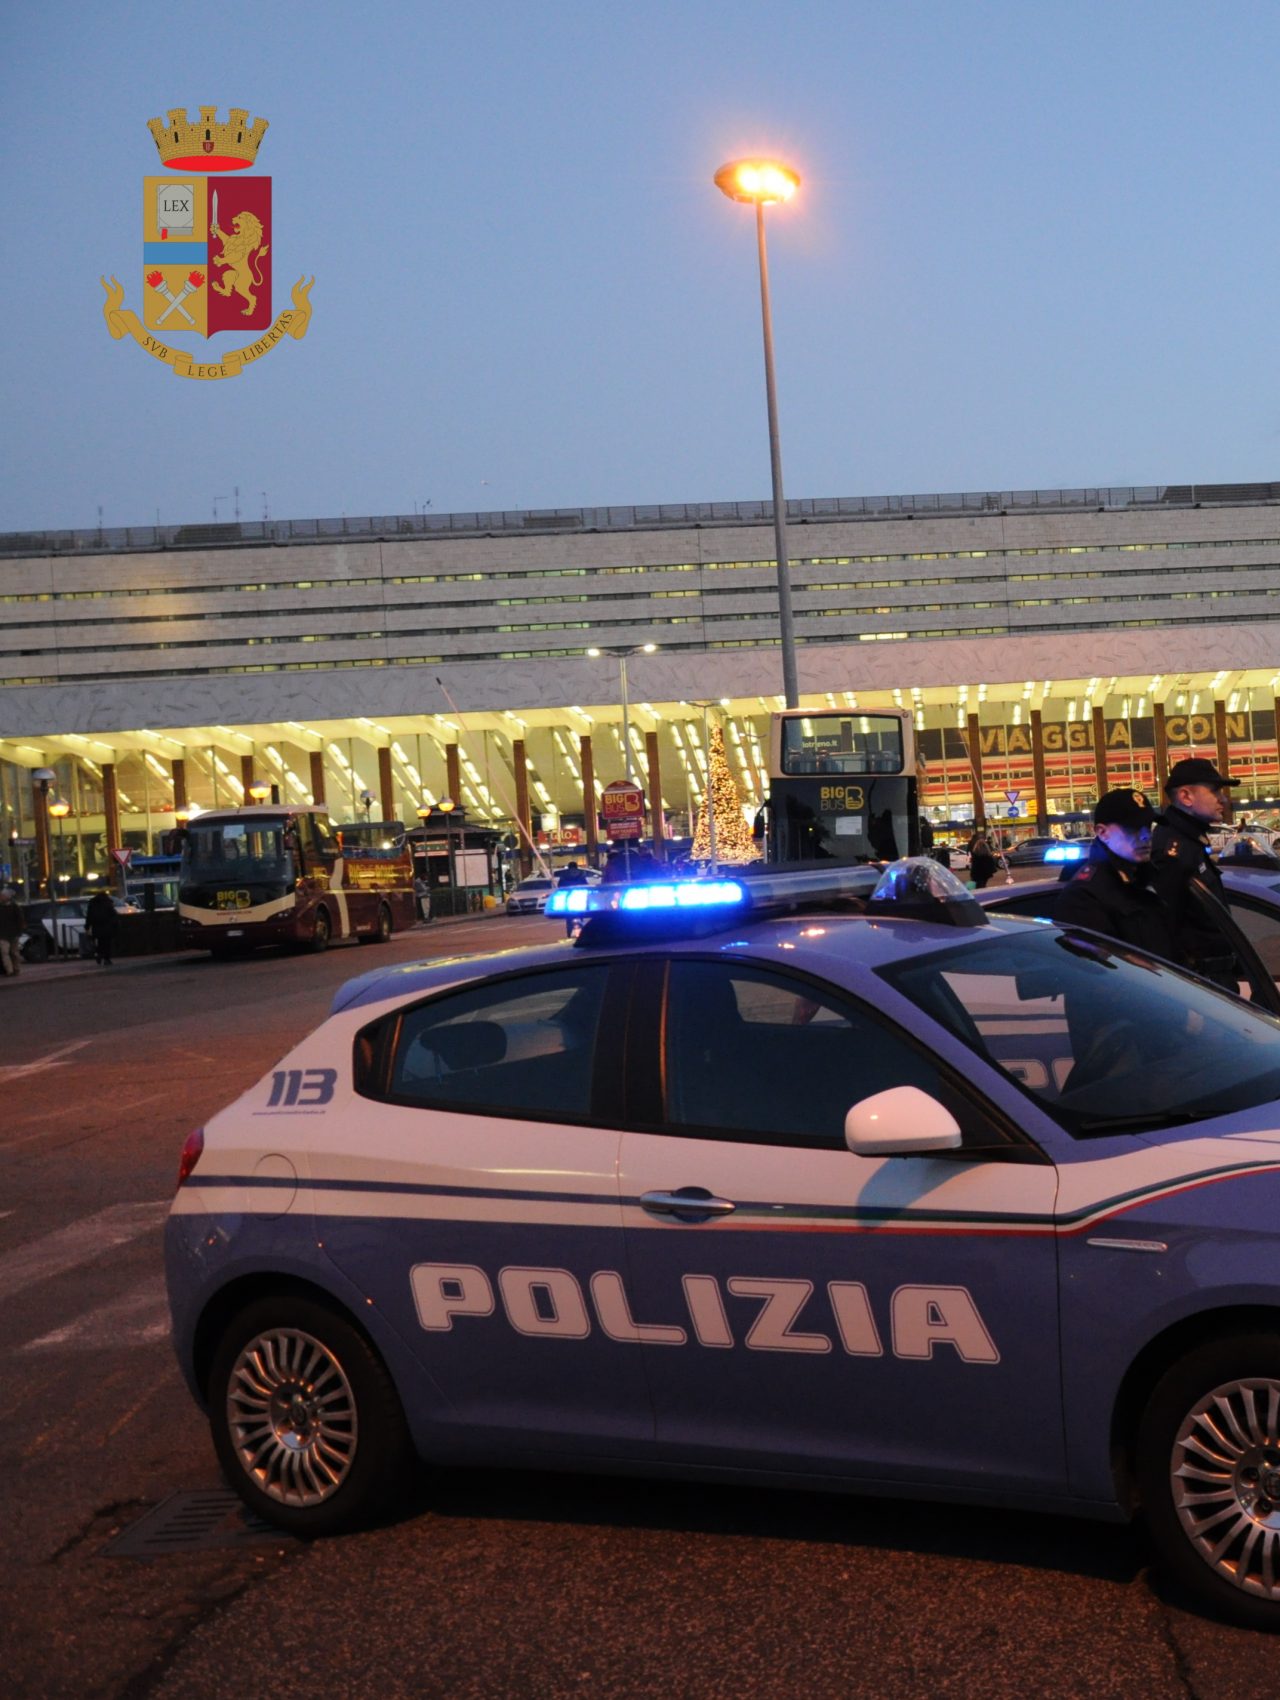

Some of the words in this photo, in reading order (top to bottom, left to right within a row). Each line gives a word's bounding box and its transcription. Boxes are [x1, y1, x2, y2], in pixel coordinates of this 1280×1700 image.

[963, 719, 1130, 753] VIAGGIA
[1166, 713, 1245, 742] CON
[604, 793, 625, 804] BIG
[820, 786, 845, 799] BIG
[605, 803, 625, 813] BUS
[820, 799, 845, 811] BUS
[217, 890, 236, 901] BIG
[266, 1068, 338, 1107] 113
[409, 1262, 1000, 1364] POLIZIA
